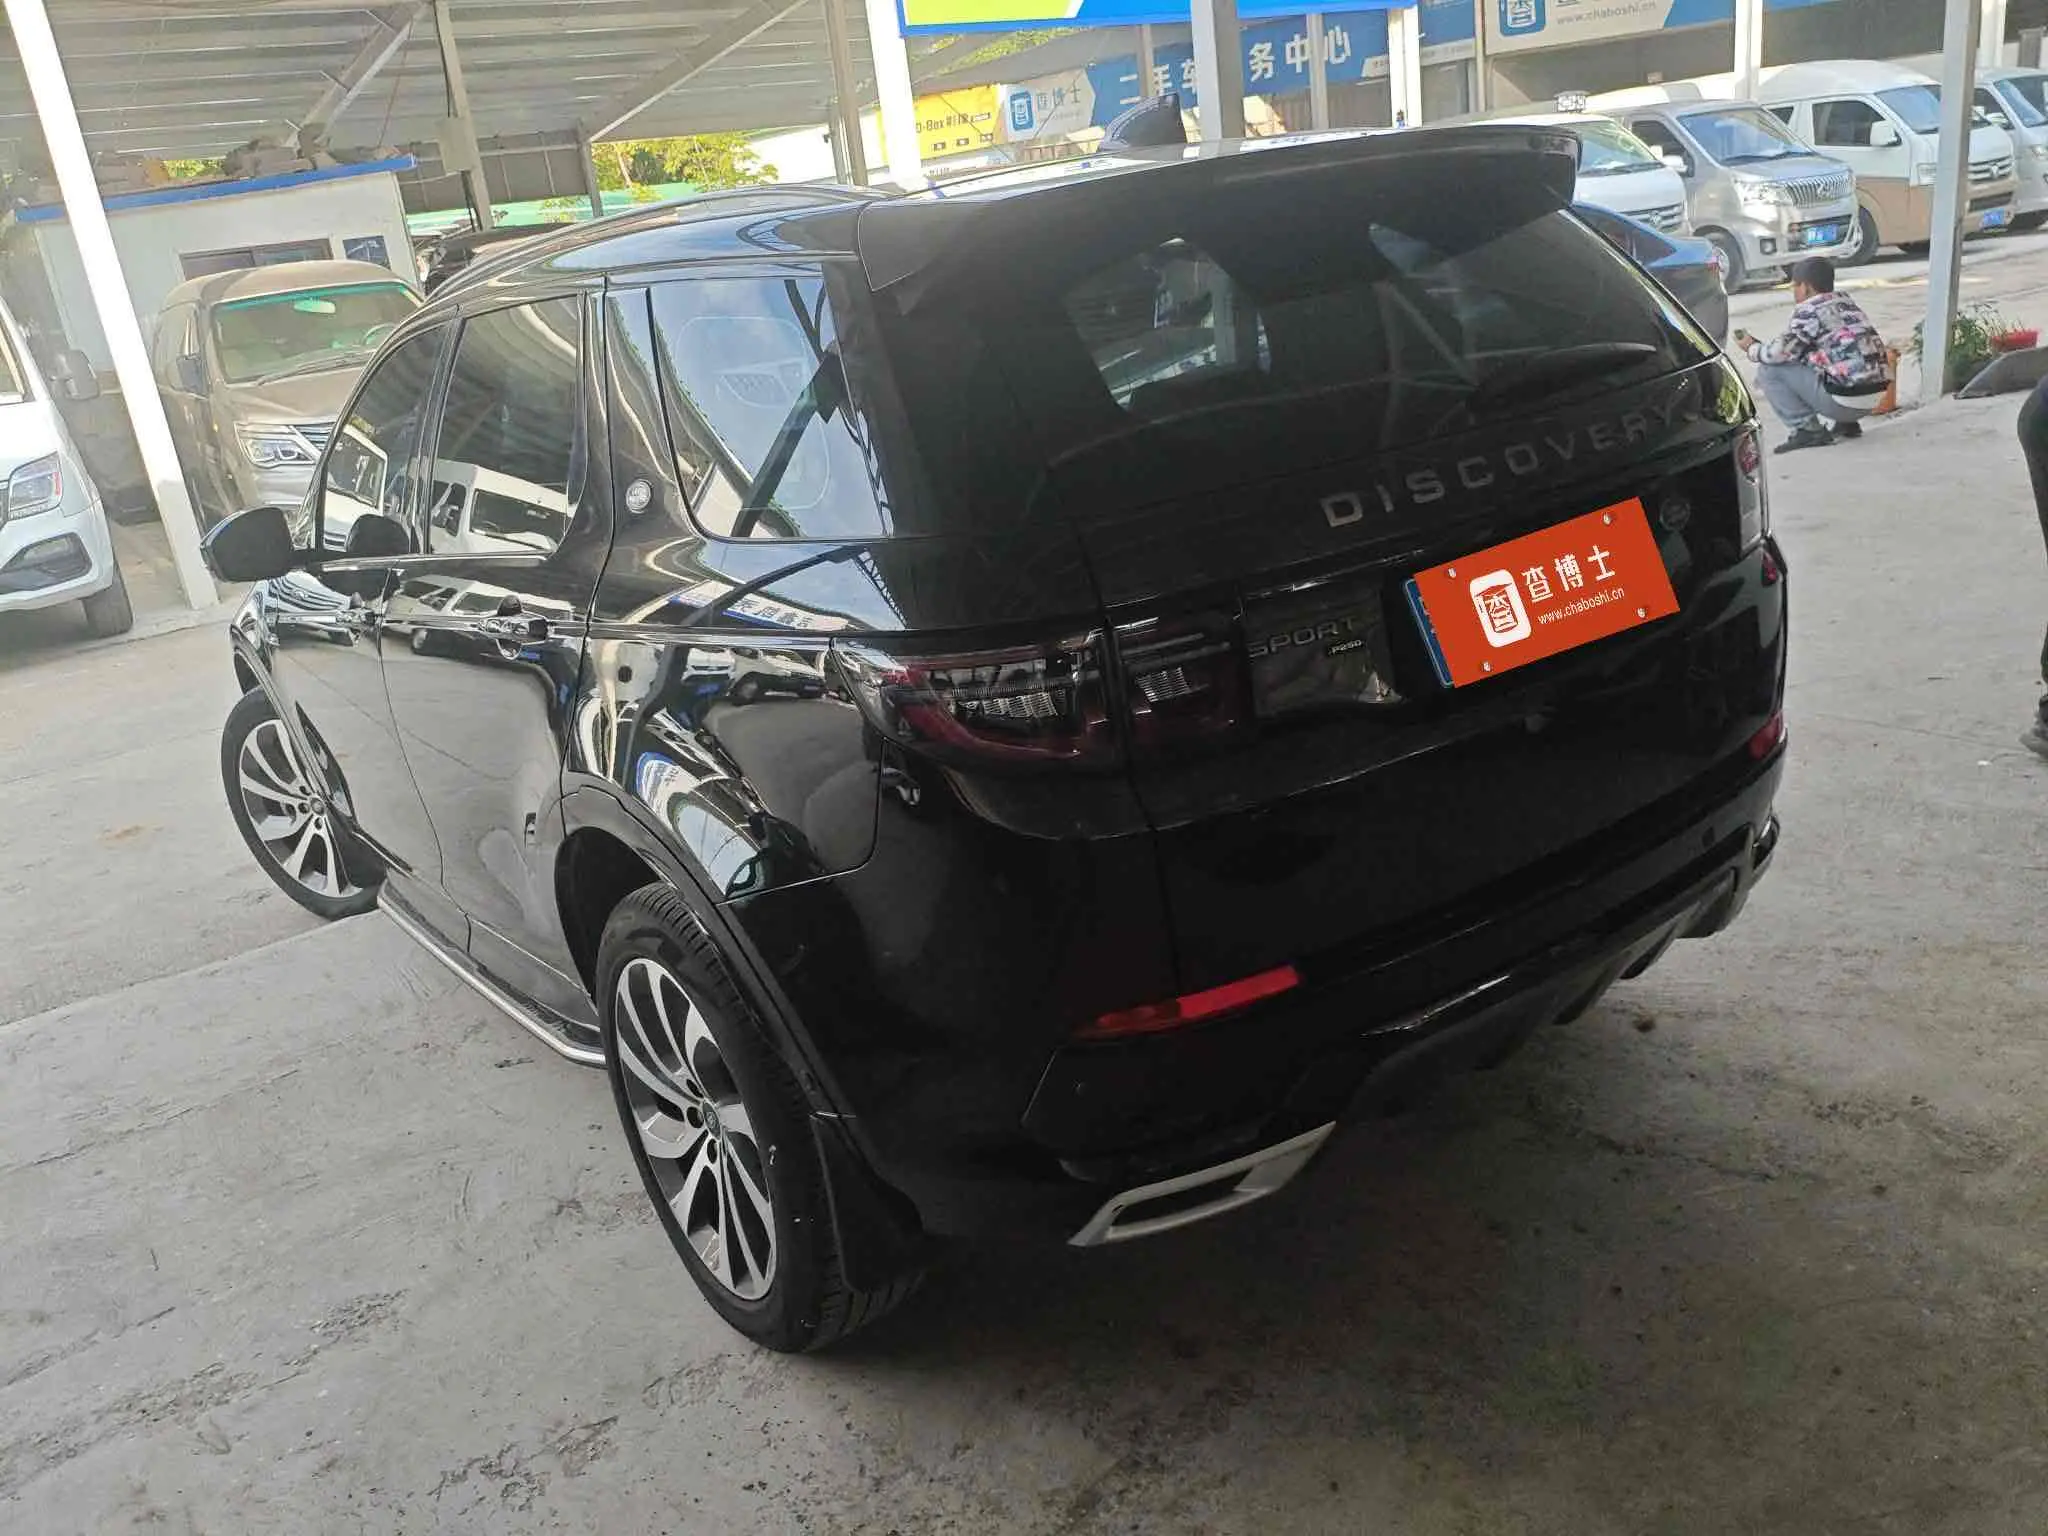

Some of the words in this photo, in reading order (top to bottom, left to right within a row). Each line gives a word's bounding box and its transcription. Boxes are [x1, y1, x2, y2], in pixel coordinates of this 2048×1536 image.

[1119, 24, 1352, 105] 二手车务中心
[1321, 403, 1676, 527] DISCOVERY
[1247, 614, 1356, 658] SPORT
